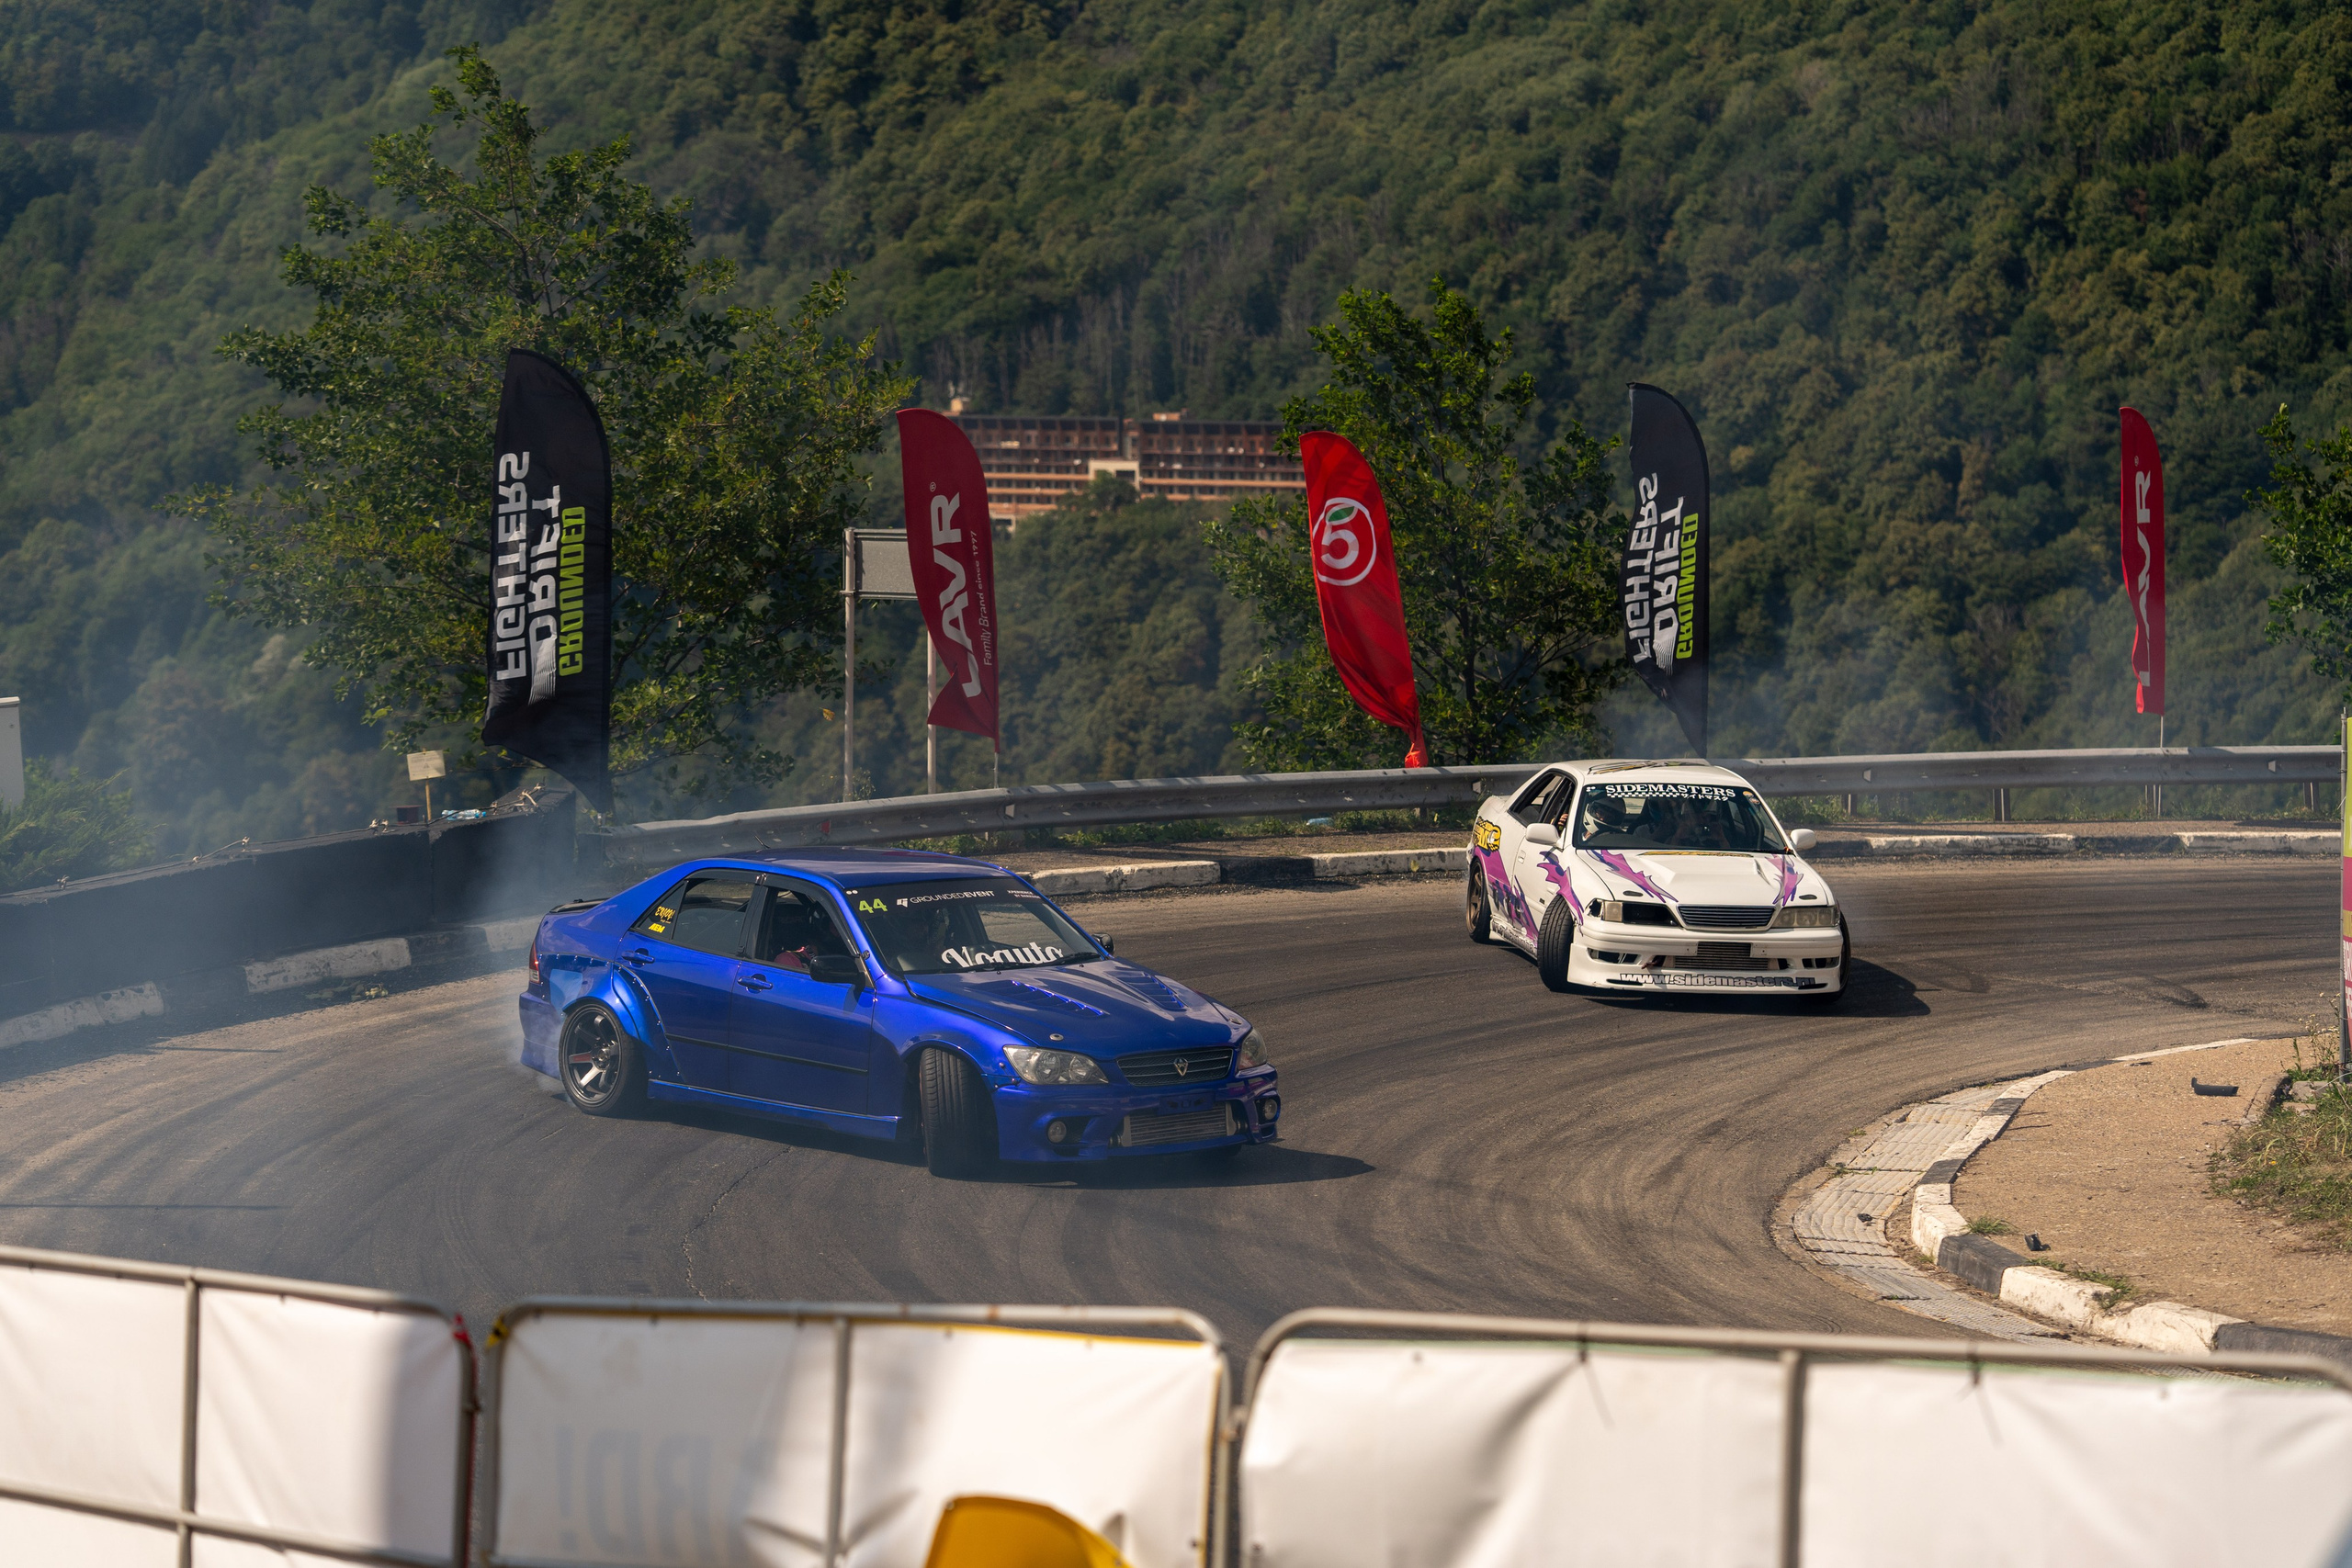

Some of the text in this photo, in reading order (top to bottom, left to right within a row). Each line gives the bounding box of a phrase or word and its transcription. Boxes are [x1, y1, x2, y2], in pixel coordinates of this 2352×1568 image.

[1321, 507, 1360, 570] 5
[930, 491, 982, 698] LAVR
[970, 530, 992, 666] Family Brand since 1997
[1605, 784, 1736, 797] SIDEMASTERS
[858, 897, 888, 914] 44
[1620, 973, 1816, 987] www.sidemasters.ru
